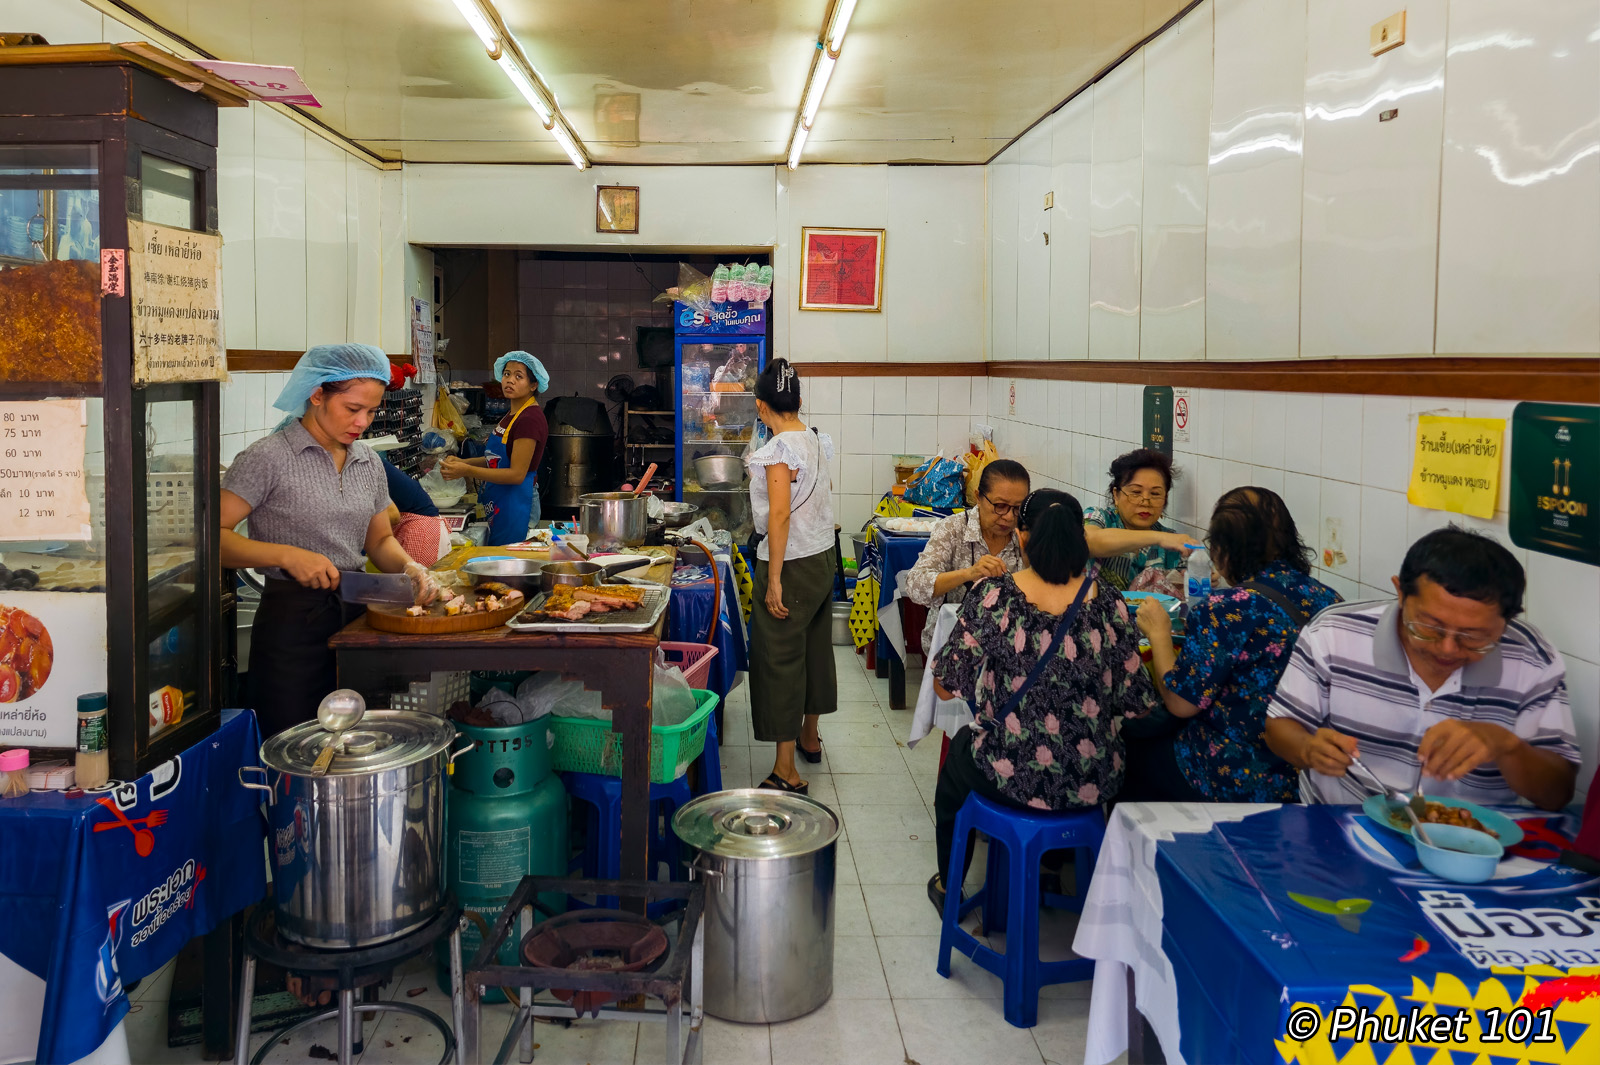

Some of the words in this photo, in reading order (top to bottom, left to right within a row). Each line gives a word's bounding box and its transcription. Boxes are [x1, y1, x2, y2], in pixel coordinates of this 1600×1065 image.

[3, 413, 15, 422] 80
[20, 413, 40, 422] บาท
[4, 428, 16, 438] 75
[21, 429, 41, 438] บาท
[5, 449, 17, 458] 60
[23, 449, 42, 458] บาท
[19, 489, 30, 498] 10
[36, 489, 55, 498] บาท
[1541, 496, 1588, 517] SPOON
[19, 508, 30, 518] 12
[36, 508, 55, 518] บาท
[132, 859, 195, 927] พระเอก
